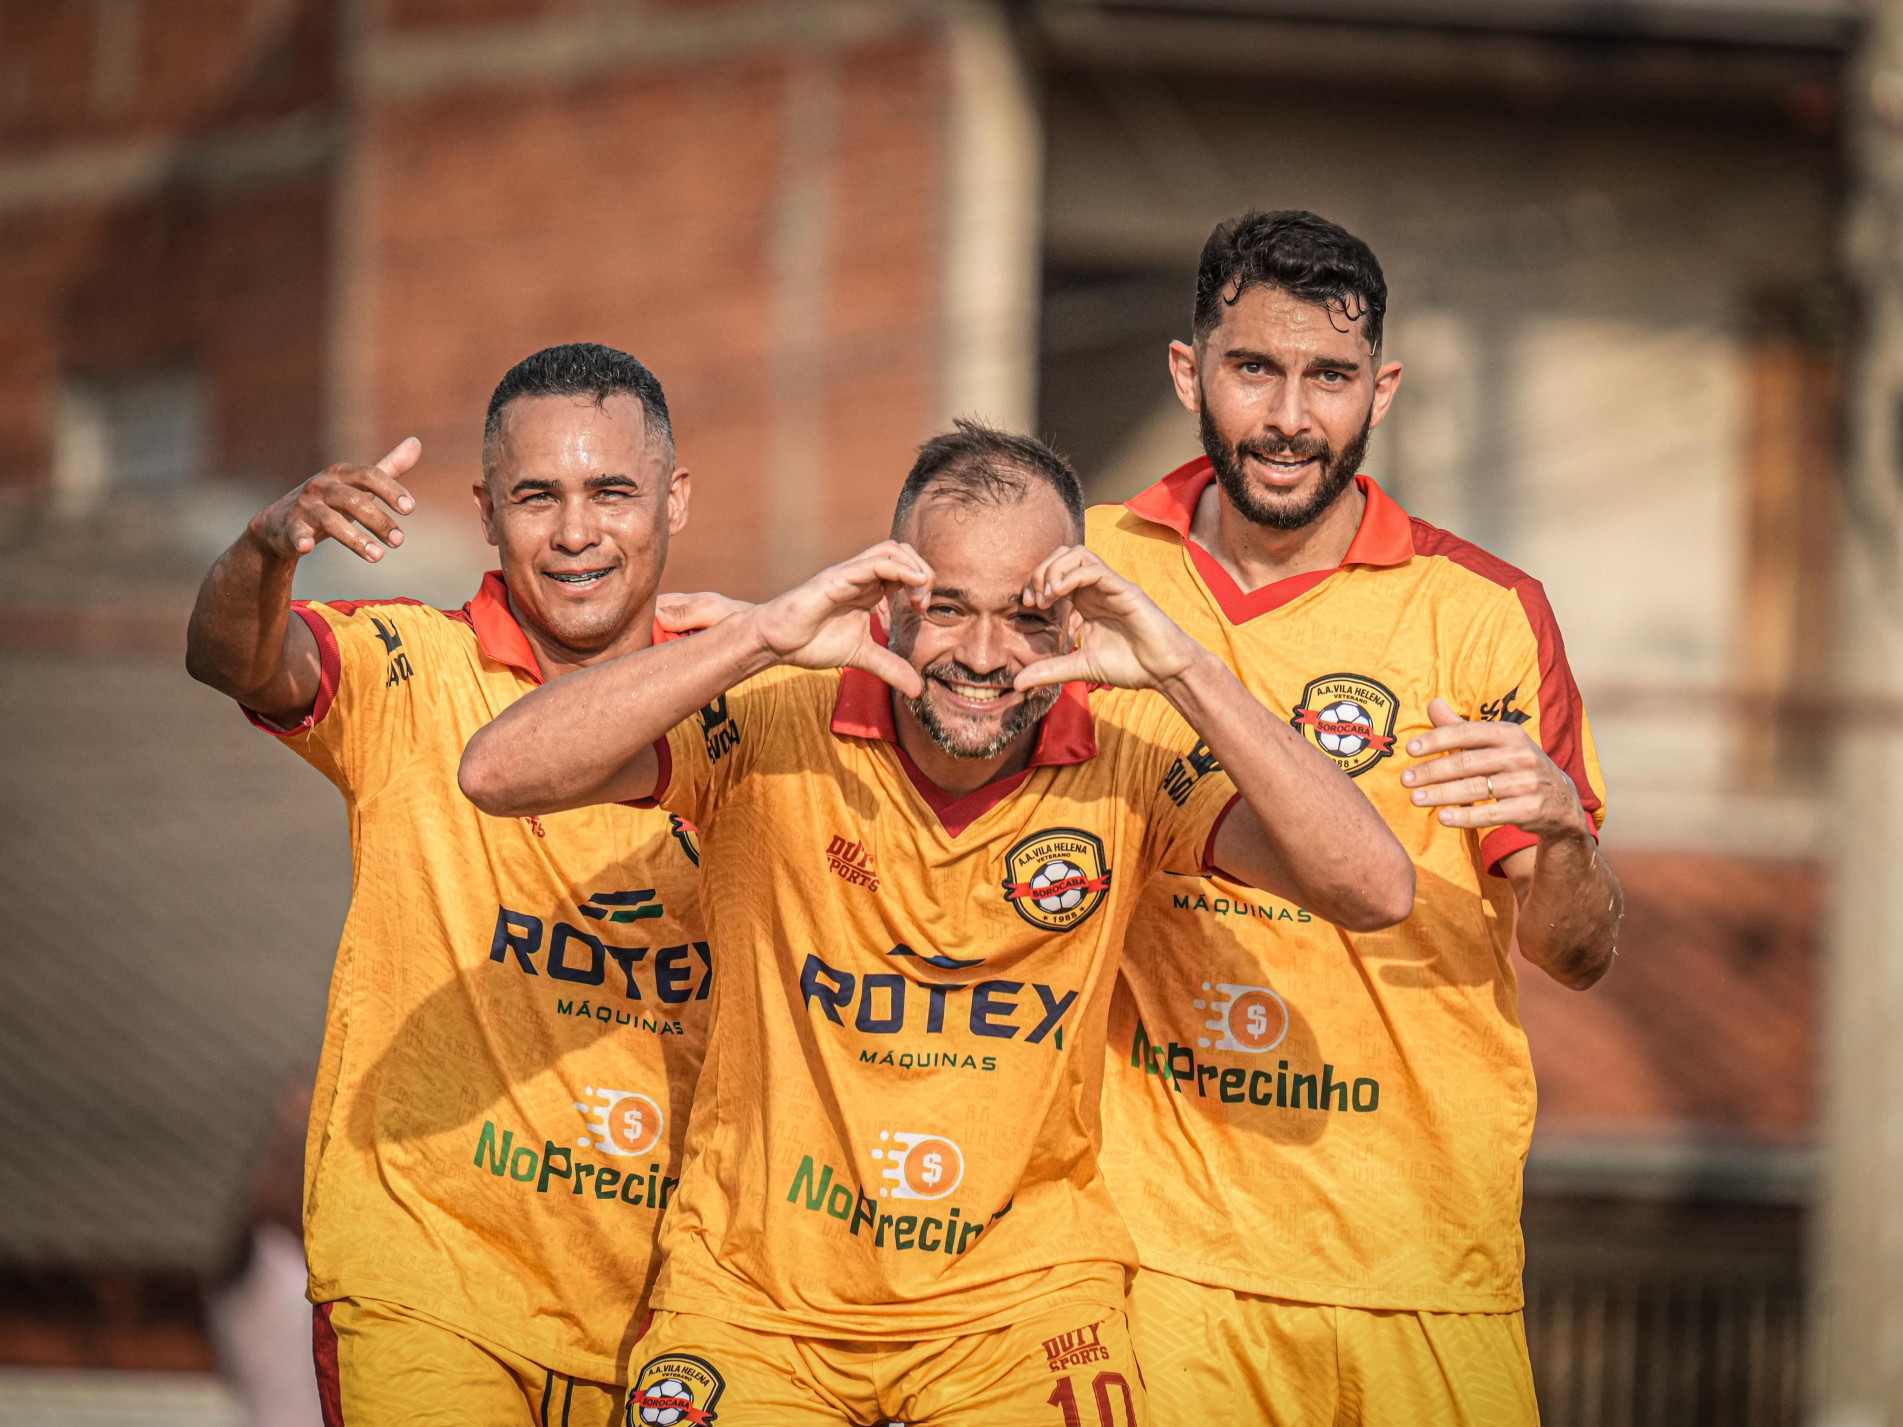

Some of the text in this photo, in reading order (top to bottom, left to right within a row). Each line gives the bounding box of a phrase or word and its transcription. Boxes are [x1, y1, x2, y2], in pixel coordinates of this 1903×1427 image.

[1333, 694, 1368, 705] VETERANO
[1354, 688, 1386, 707] HELENA
[1317, 721, 1371, 736] SOROCABA
[1036, 852, 1071, 863] VETERANO
[1053, 842, 1088, 855] HELENA
[827, 857, 880, 893] PORTS
[1032, 879, 1087, 897] SOROCABA
[1172, 894, 1312, 923] MÁQUINAS
[800, 953, 1079, 1044] ROTEX
[557, 999, 685, 1035] MÁQUINAS
[858, 1049, 997, 1072] MÁQUINAS
[1041, 1321, 1101, 1360] DUTY
[1049, 1346, 1110, 1372] SPORTS
[681, 1366, 710, 1388] HELENA
